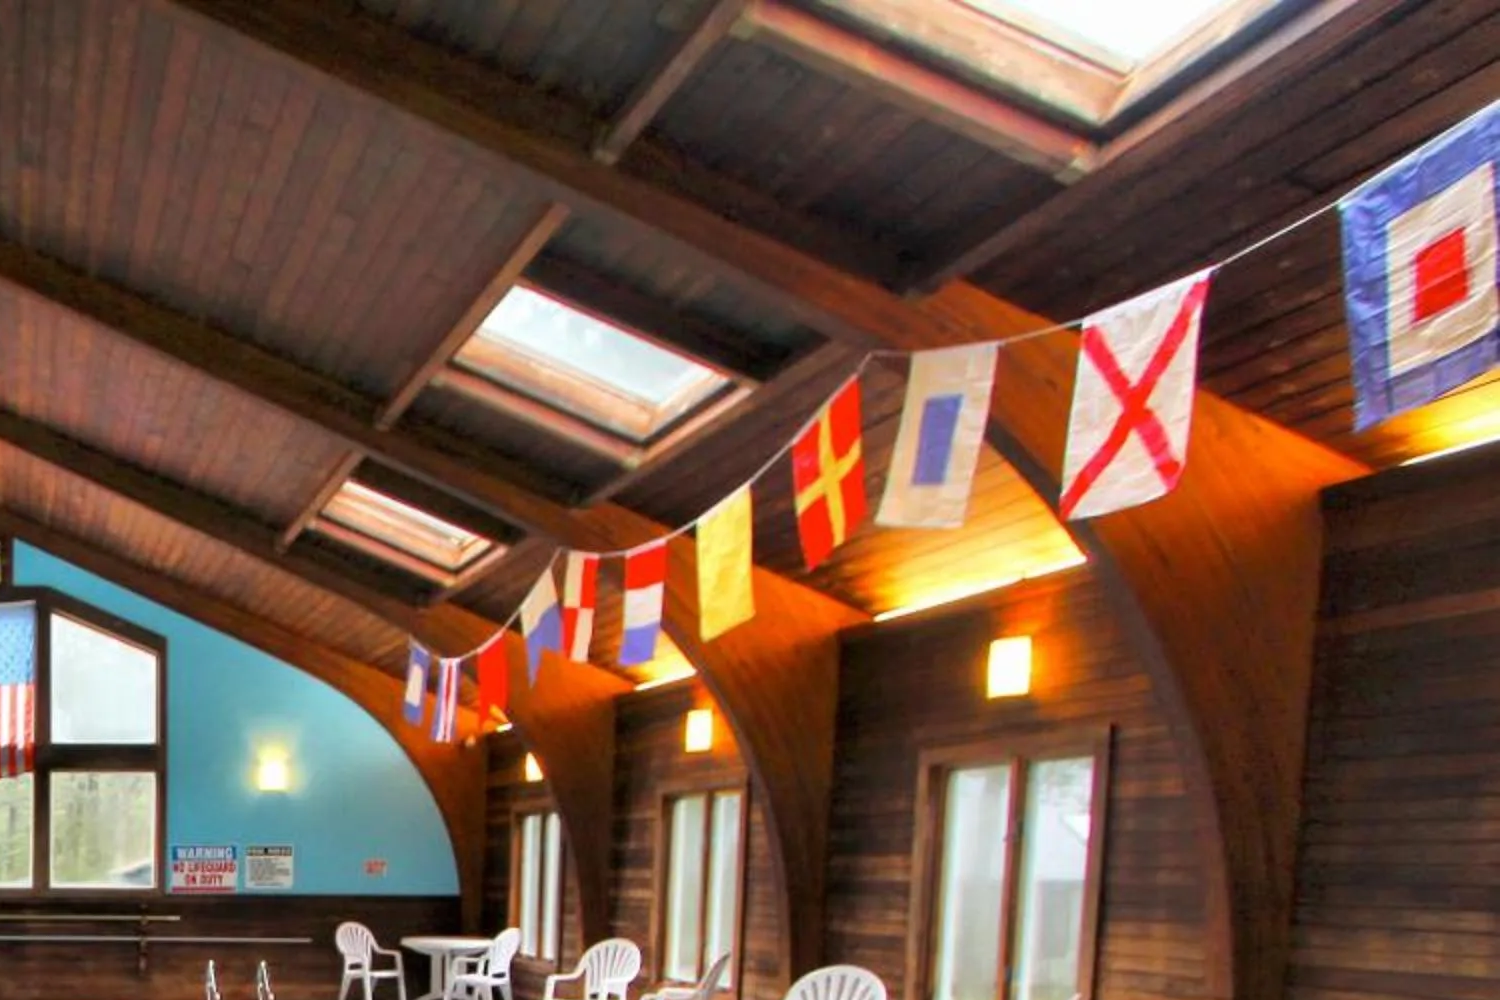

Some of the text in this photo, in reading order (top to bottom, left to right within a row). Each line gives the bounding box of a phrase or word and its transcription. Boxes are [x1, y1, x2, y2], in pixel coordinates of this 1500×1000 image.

[177, 847, 233, 859] WARNING
[173, 862, 236, 873] NO LIFEGUARD
[185, 874, 223, 885] ON DUTY
